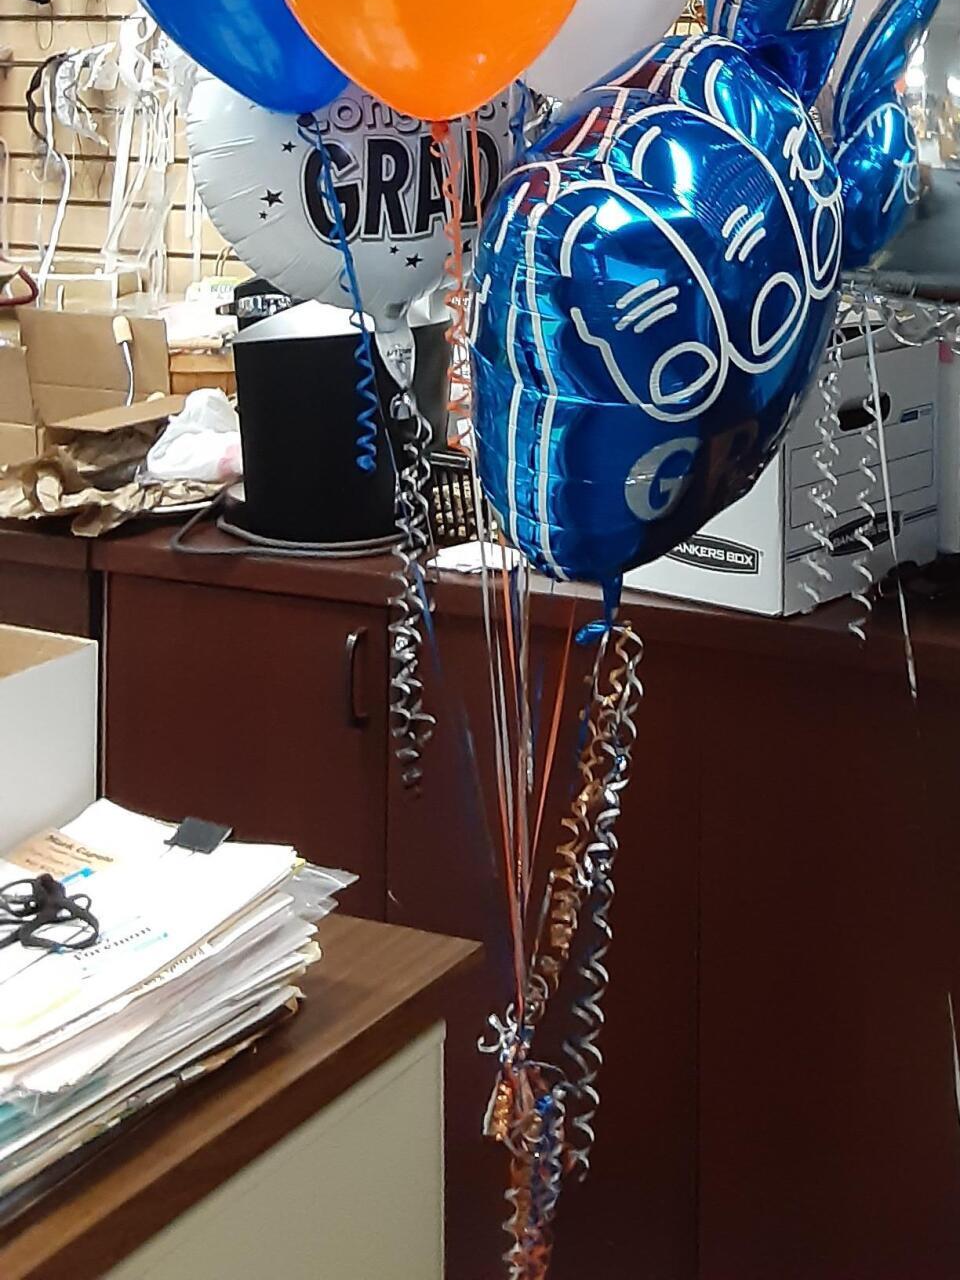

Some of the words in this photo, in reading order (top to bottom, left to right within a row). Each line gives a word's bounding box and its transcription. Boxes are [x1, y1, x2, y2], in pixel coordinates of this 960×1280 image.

[301, 128, 503, 244] GRAD
[674, 542, 725, 561] ANKERS
[726, 551, 753, 567] BOX
